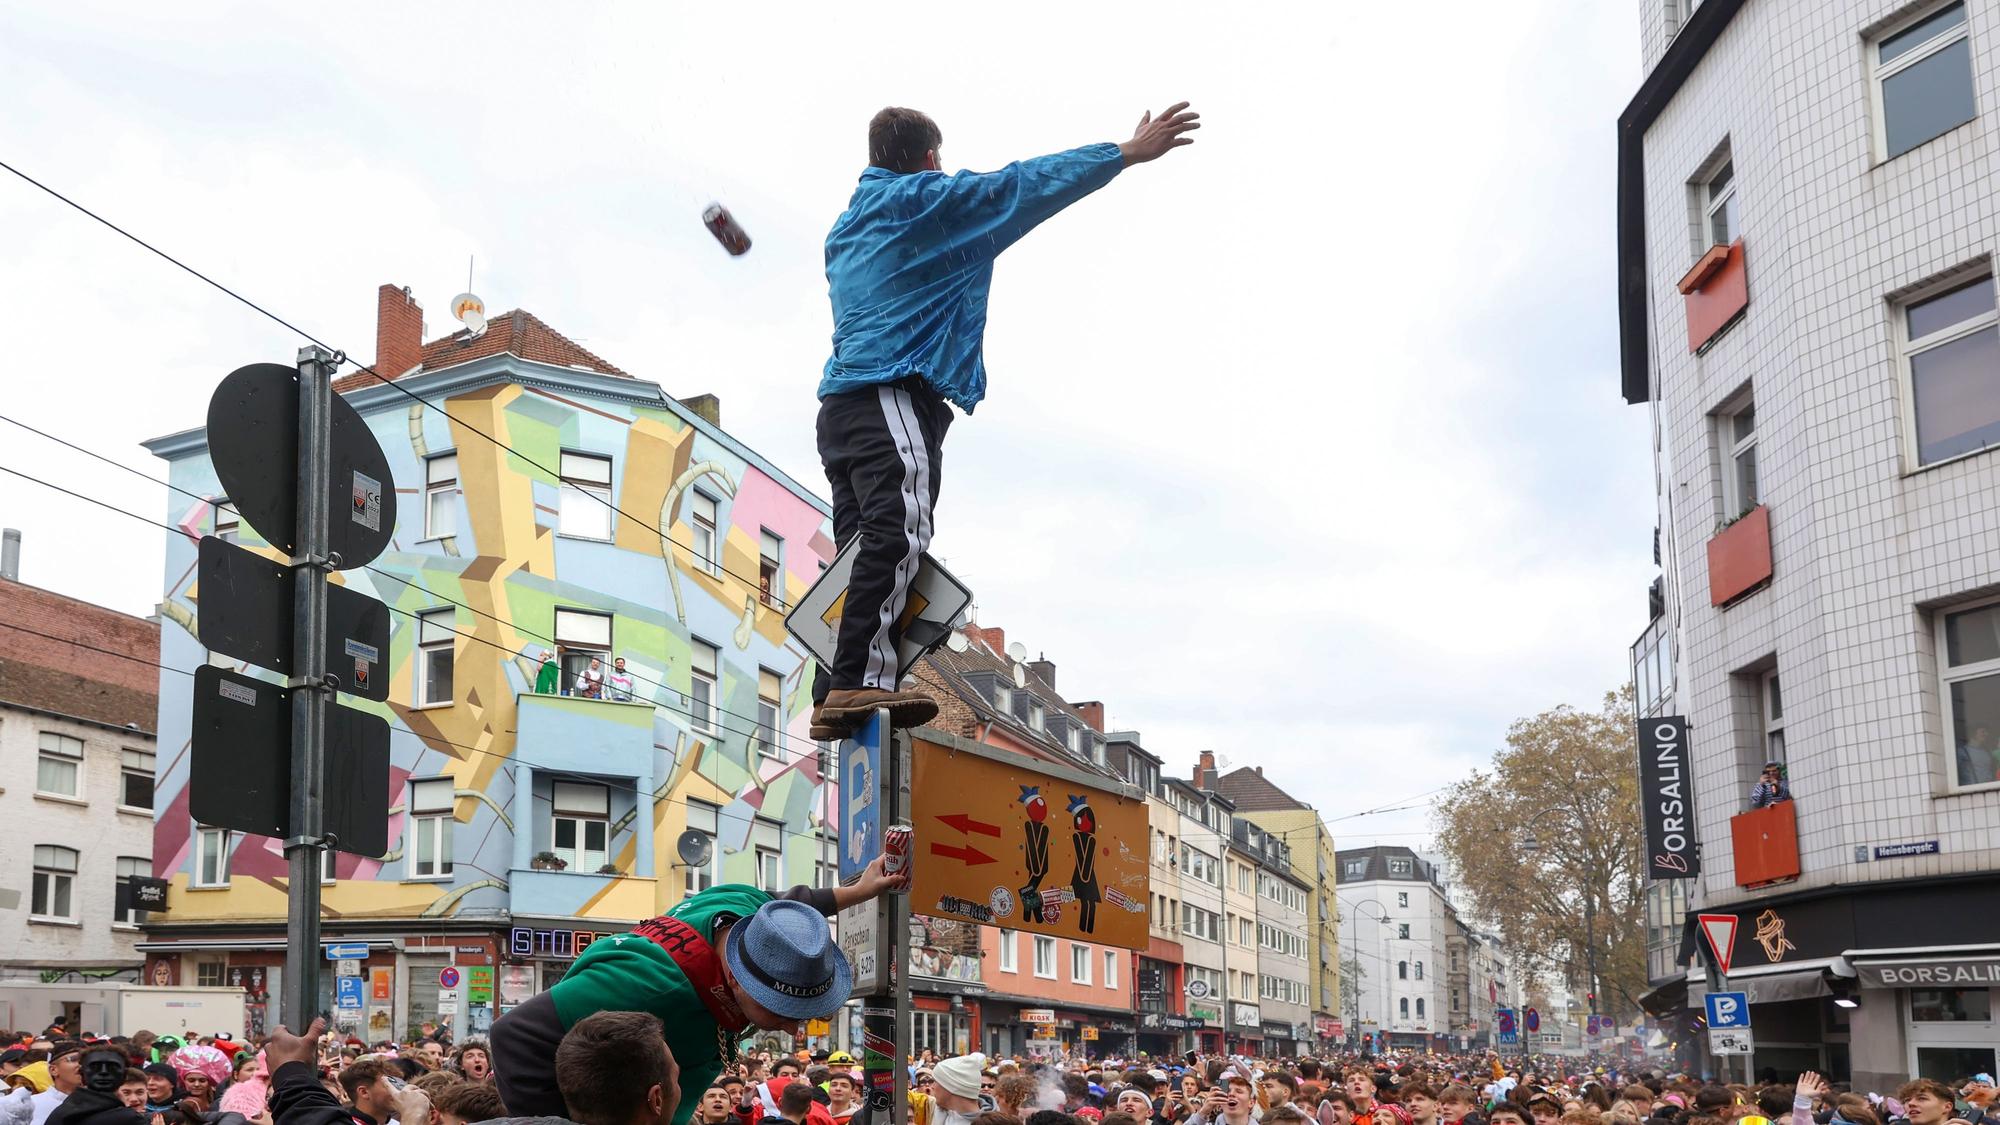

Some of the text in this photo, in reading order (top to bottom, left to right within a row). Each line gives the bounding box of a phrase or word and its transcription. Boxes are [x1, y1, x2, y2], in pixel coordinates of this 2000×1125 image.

[847, 744, 870, 860] P
[1654, 722, 1689, 873] BORSALINO
[1879, 842, 1934, 857] Heinsbergstr.
[515, 931, 609, 955] STIE
[844, 925, 870, 949] Parkschein
[1714, 996, 1738, 1024] P
[1500, 1035, 1516, 1043] AXI
